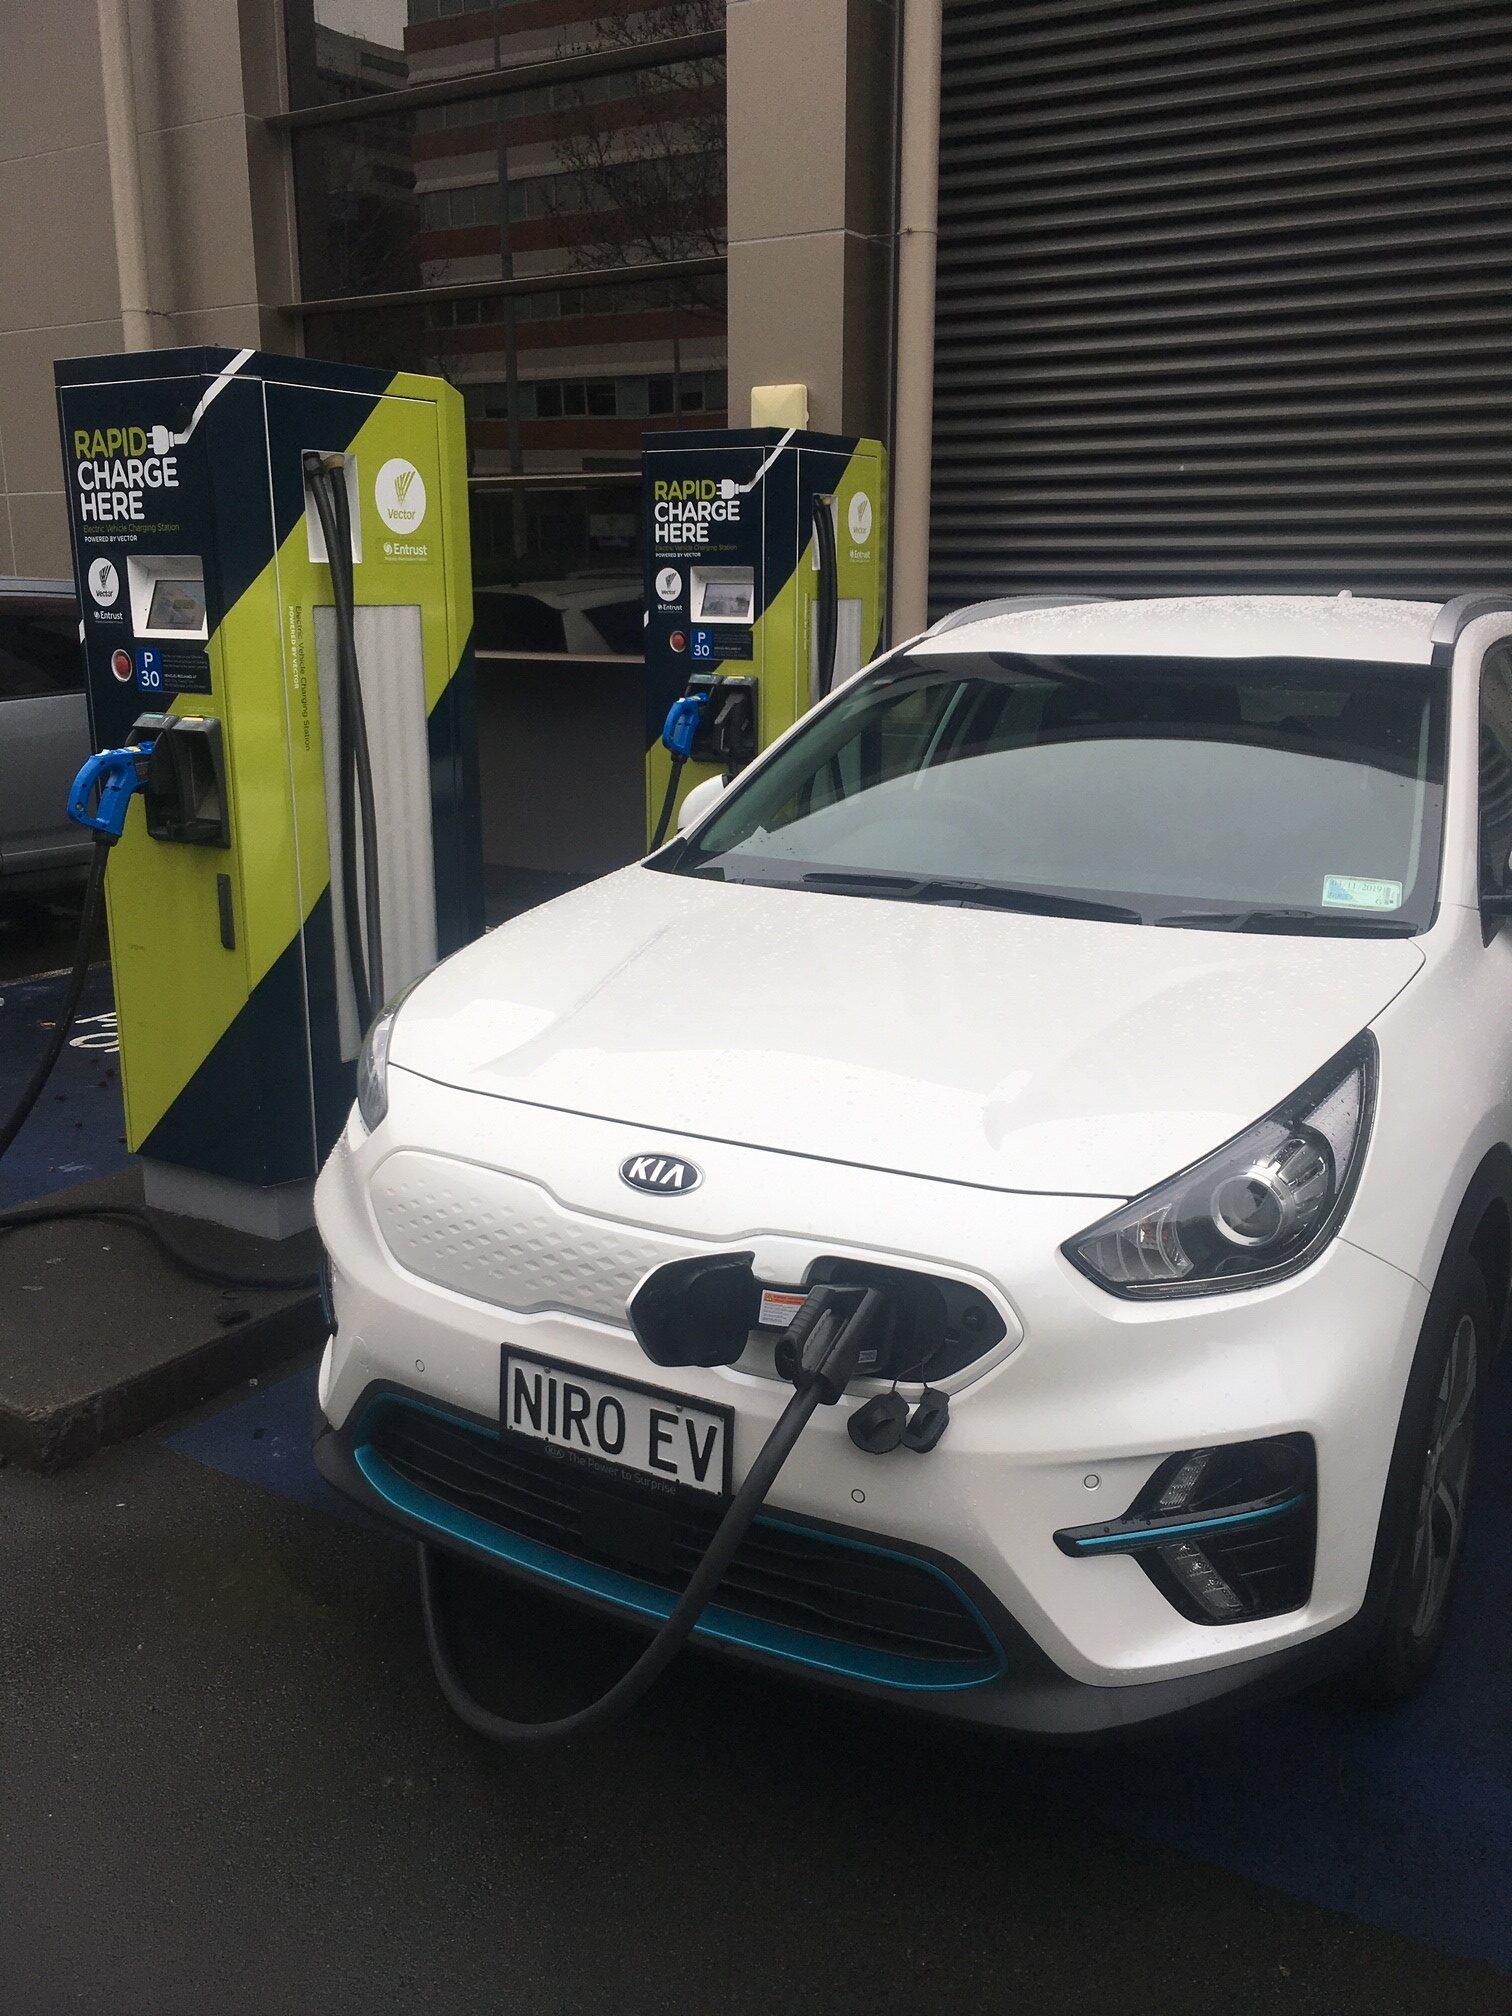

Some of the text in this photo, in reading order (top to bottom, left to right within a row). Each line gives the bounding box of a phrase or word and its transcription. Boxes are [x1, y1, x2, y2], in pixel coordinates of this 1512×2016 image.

[74, 426, 147, 459] RAPID
[77, 457, 180, 491] CHARGE
[654, 479, 717, 500] RAPID
[80, 491, 145, 521] HERE
[387, 508, 416, 520] Vector
[654, 501, 741, 522] CHARGE
[83, 523, 180, 534] Electric Vehicle Charging Station
[84, 535, 109, 543] POWERED
[117, 534, 138, 542] VECTOR
[655, 522, 710, 543] HERE
[393, 543, 428, 556] Entrust
[95, 589, 113, 598] Vector
[100, 611, 123, 620] Entrust
[295, 605, 304, 639] Electric
[288, 606, 300, 689] POWERED BY VECTOR
[698, 632, 706, 643] P
[144, 652, 154, 668] P
[693, 644, 710, 657] 30
[141, 671, 160, 687] 30
[300, 677, 308, 718] Charging
[303, 720, 311, 751] Station
[1361, 884, 1383, 892] 2019
[628, 1157, 685, 1188] KIA
[513, 1367, 718, 1483] NIRO EV
[568, 1453, 586, 1467] The
[587, 1458, 620, 1477] Power
[621, 1467, 632, 1481] to
[633, 1473, 677, 1496] Surprise
